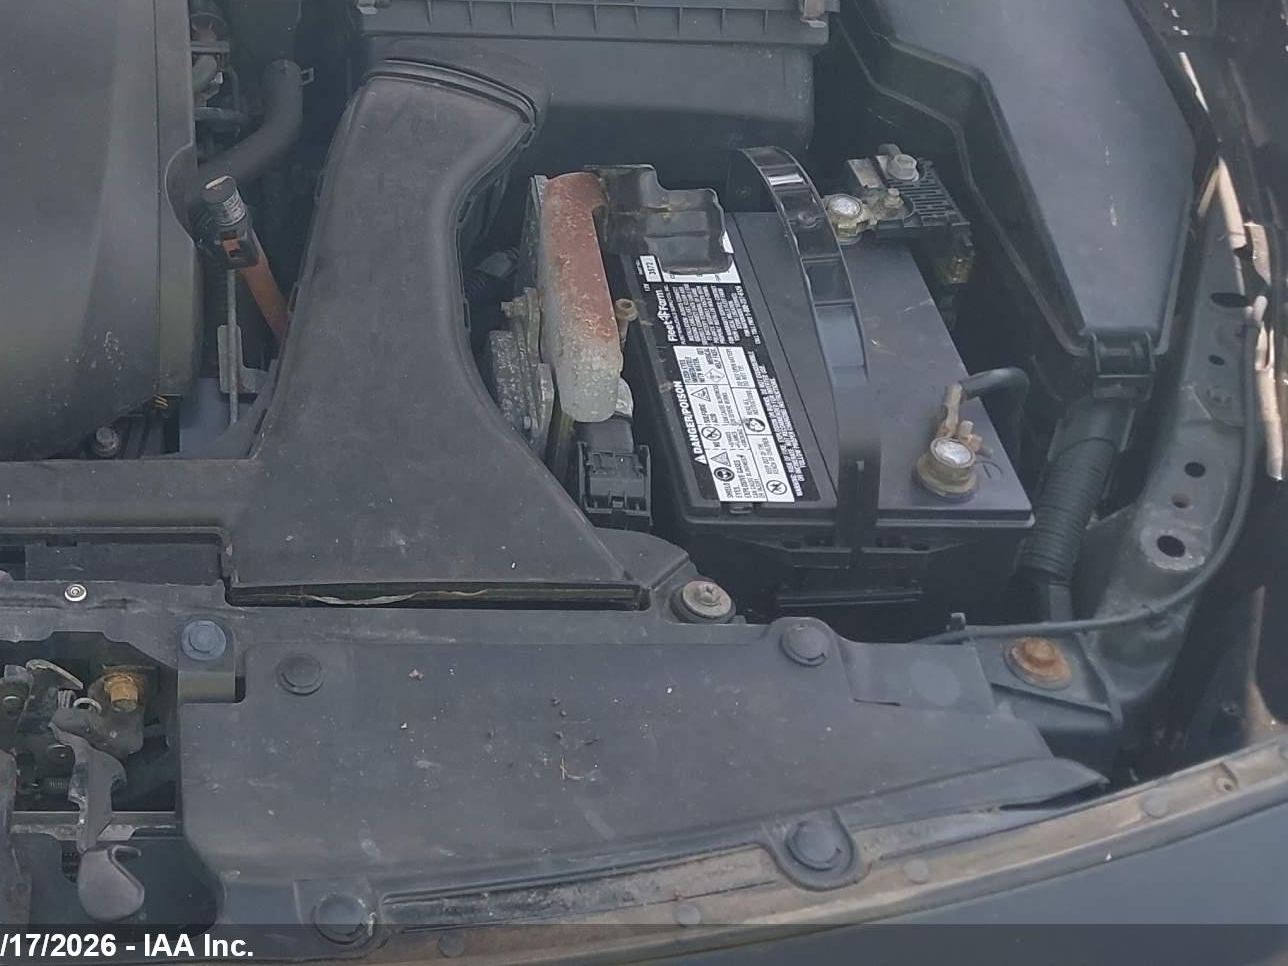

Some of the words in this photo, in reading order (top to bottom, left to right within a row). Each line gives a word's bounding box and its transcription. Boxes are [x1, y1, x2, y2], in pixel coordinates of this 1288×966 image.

[653, 289, 669, 310] Farm
[662, 320, 678, 341] Fleet
[672, 380, 704, 453] DANGER/POISON
